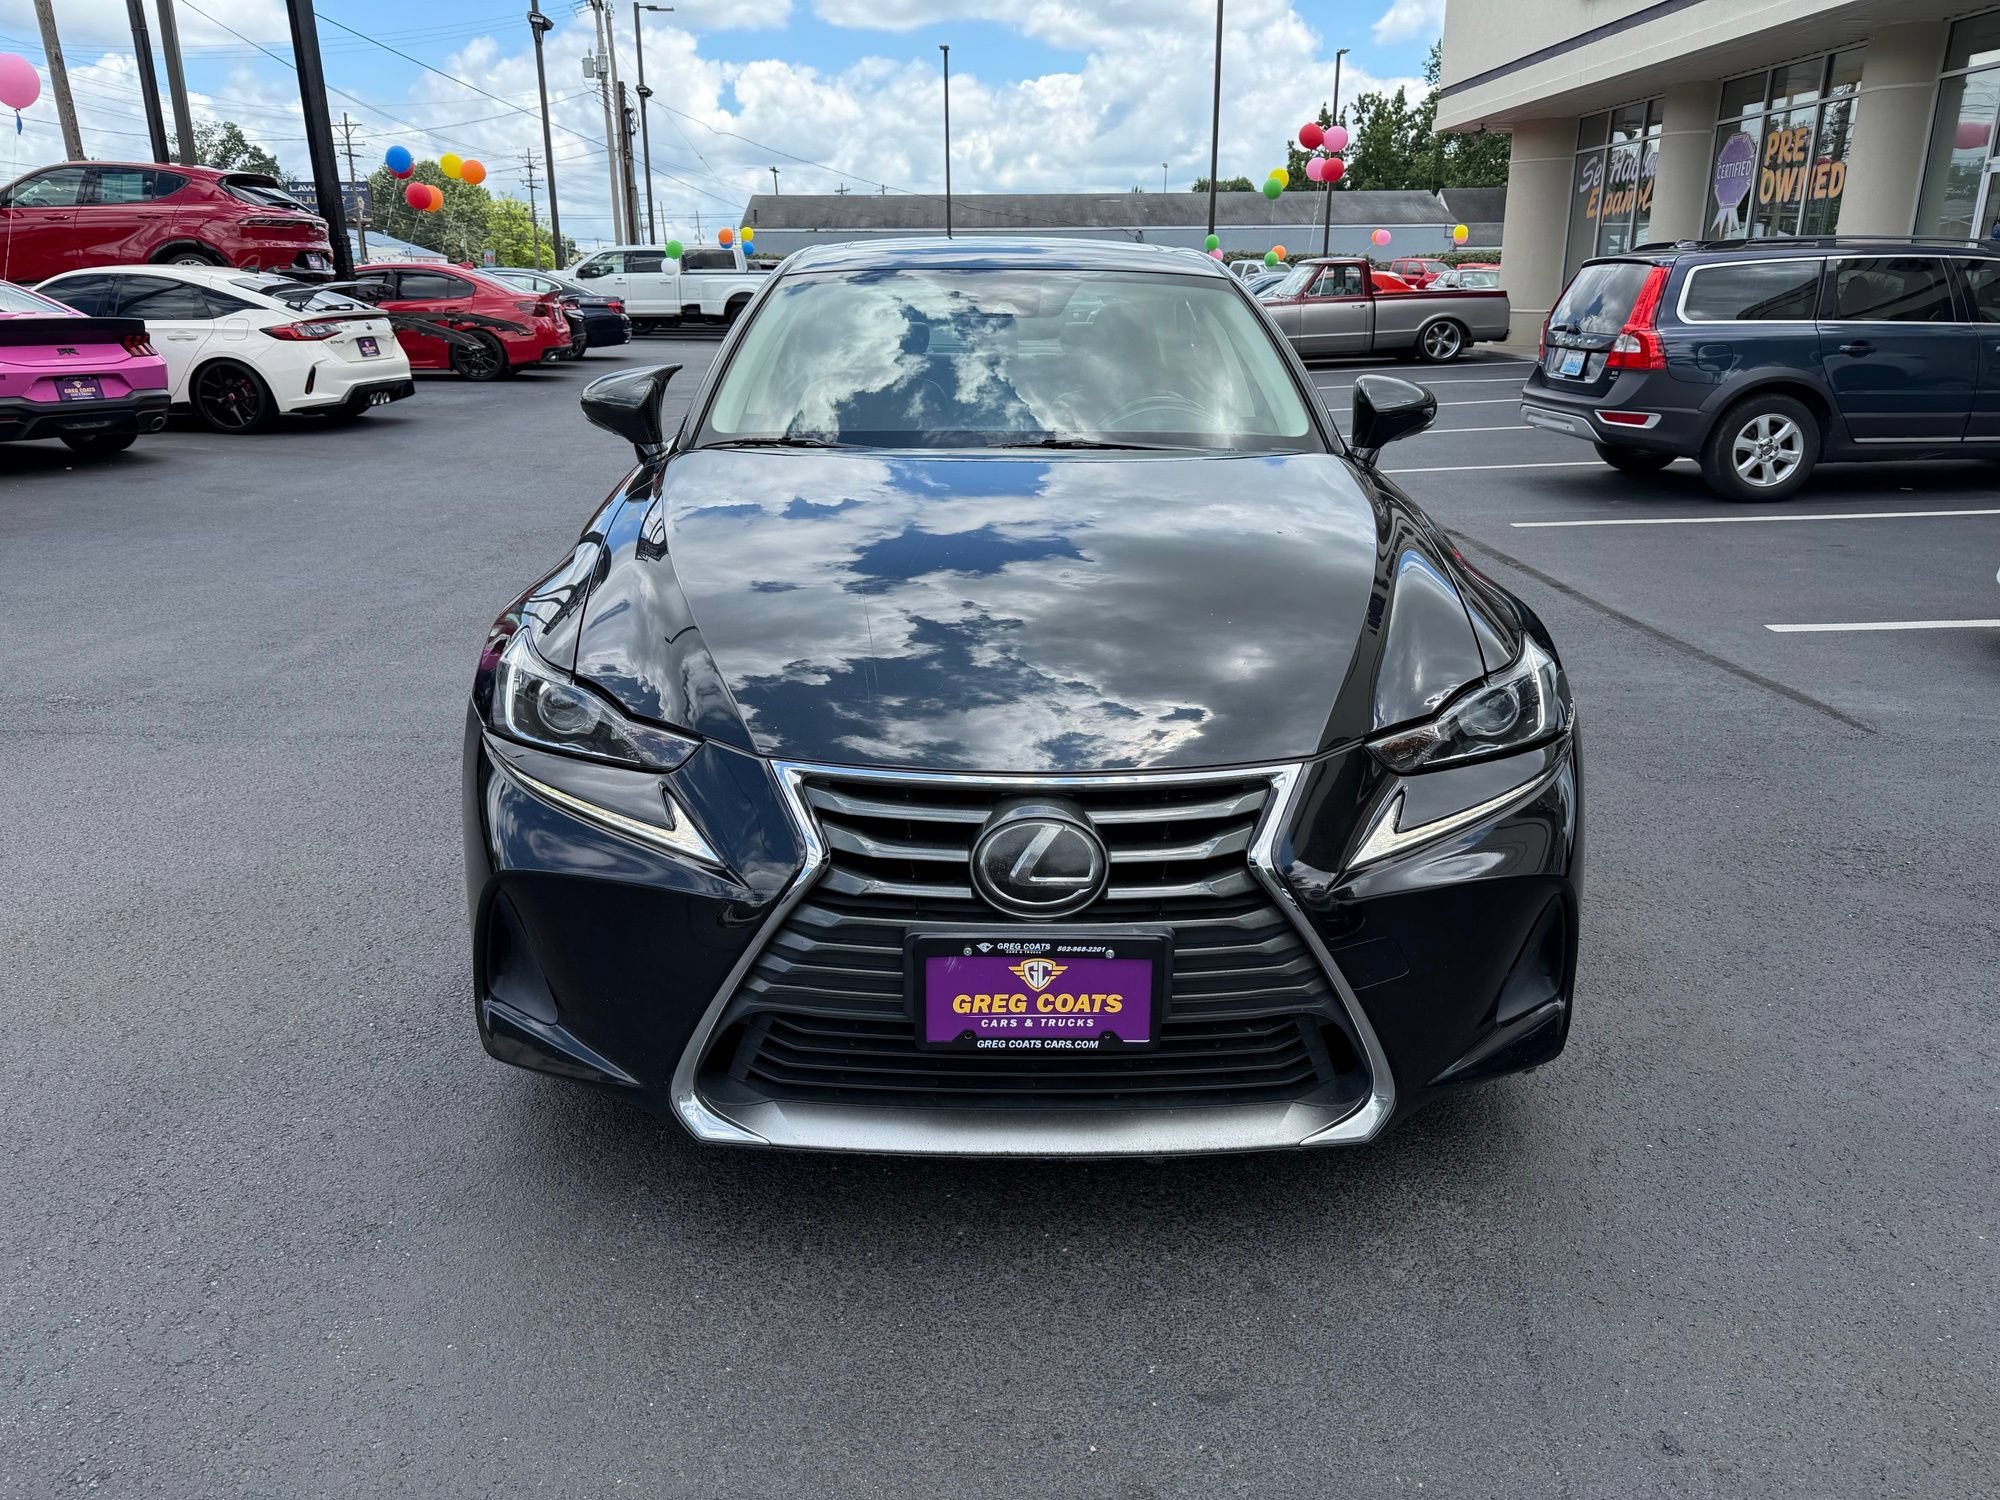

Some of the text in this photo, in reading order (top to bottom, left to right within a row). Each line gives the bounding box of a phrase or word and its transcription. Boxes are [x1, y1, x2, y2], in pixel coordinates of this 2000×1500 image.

[1765, 127, 1809, 166] PRE
[1579, 156, 1602, 194] Se
[1716, 160, 1753, 180] CERTIFIED
[997, 942, 1051, 951] GREG COATS
[952, 993, 1124, 1013] GREG COATS
[980, 1018, 1095, 1028] CARS & TRUCKS
[976, 1039, 1099, 1049] GREG COATS CARS.COM
